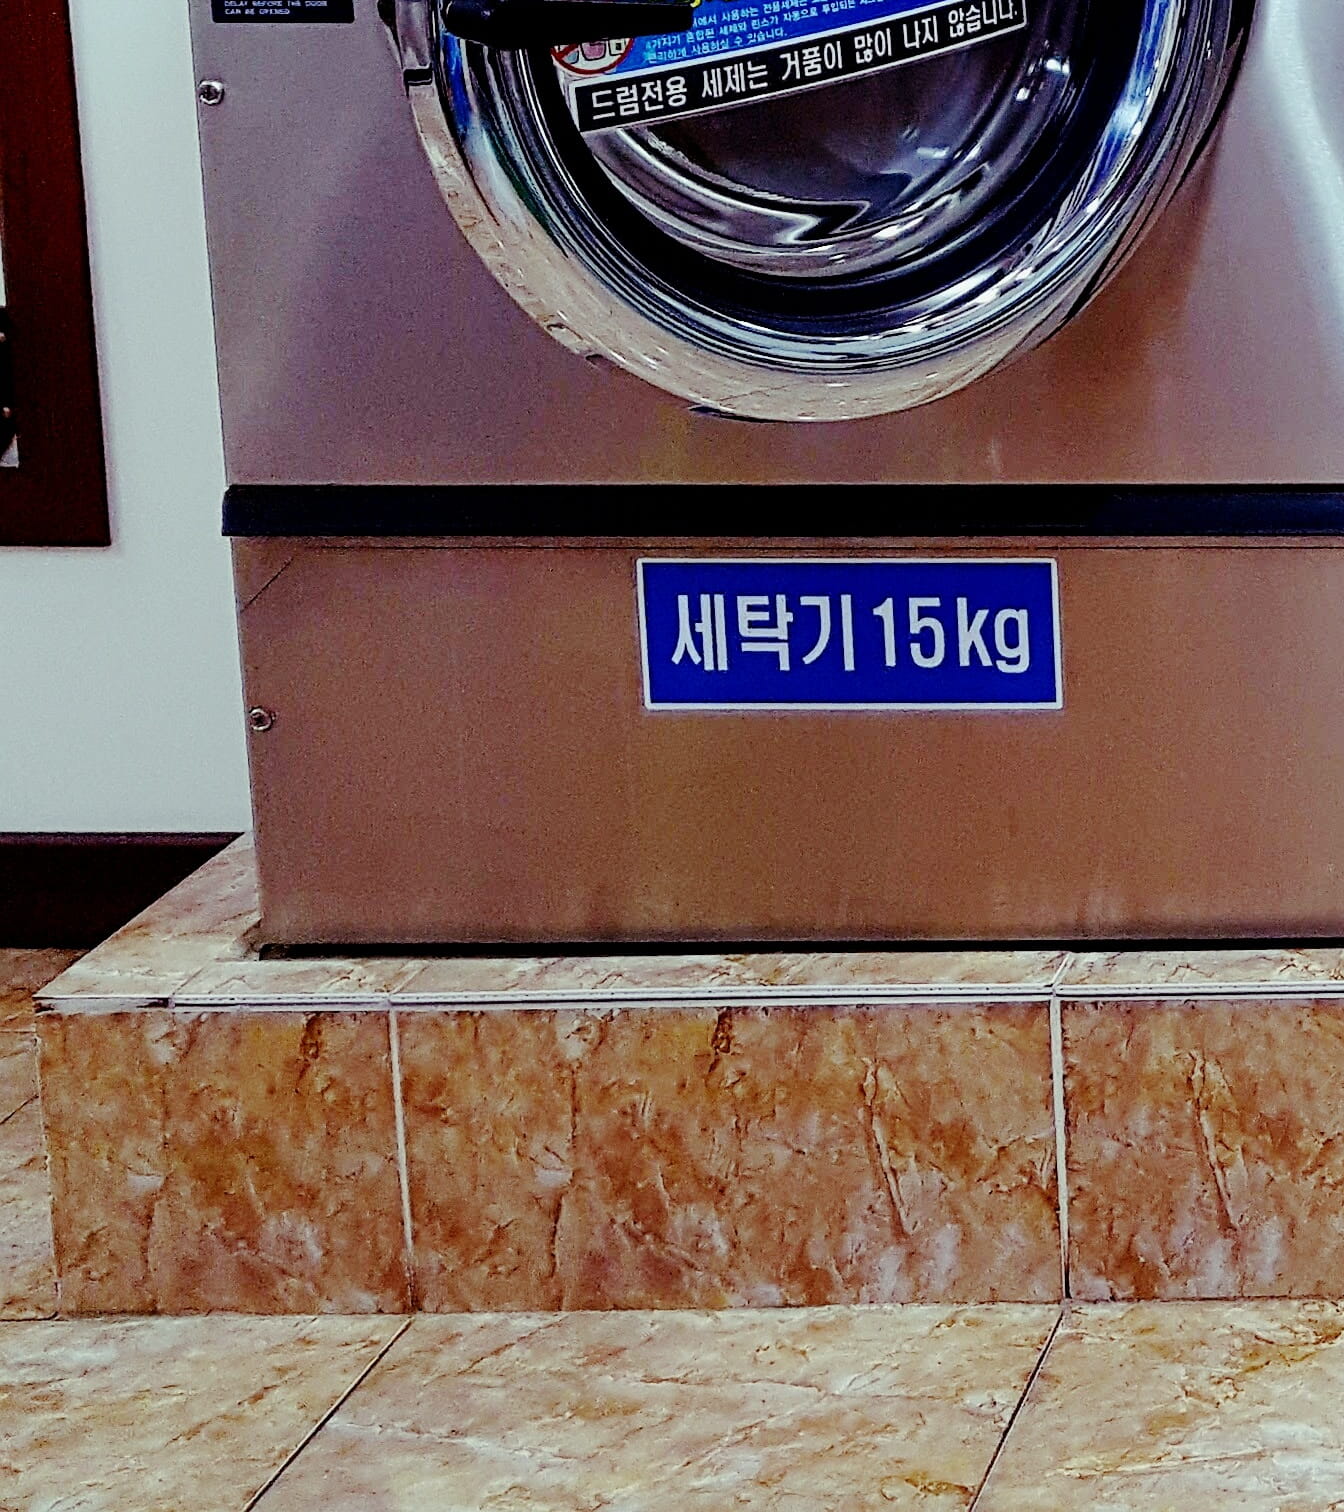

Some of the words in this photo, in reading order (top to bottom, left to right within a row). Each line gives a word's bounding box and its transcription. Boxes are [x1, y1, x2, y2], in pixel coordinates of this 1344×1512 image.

[592, 76, 688, 120] 드럼전용
[702, 62, 771, 99] 세제는
[783, 46, 843, 79] 거품이
[855, 32, 893, 65] 많이
[904, 17, 939, 50] 나지
